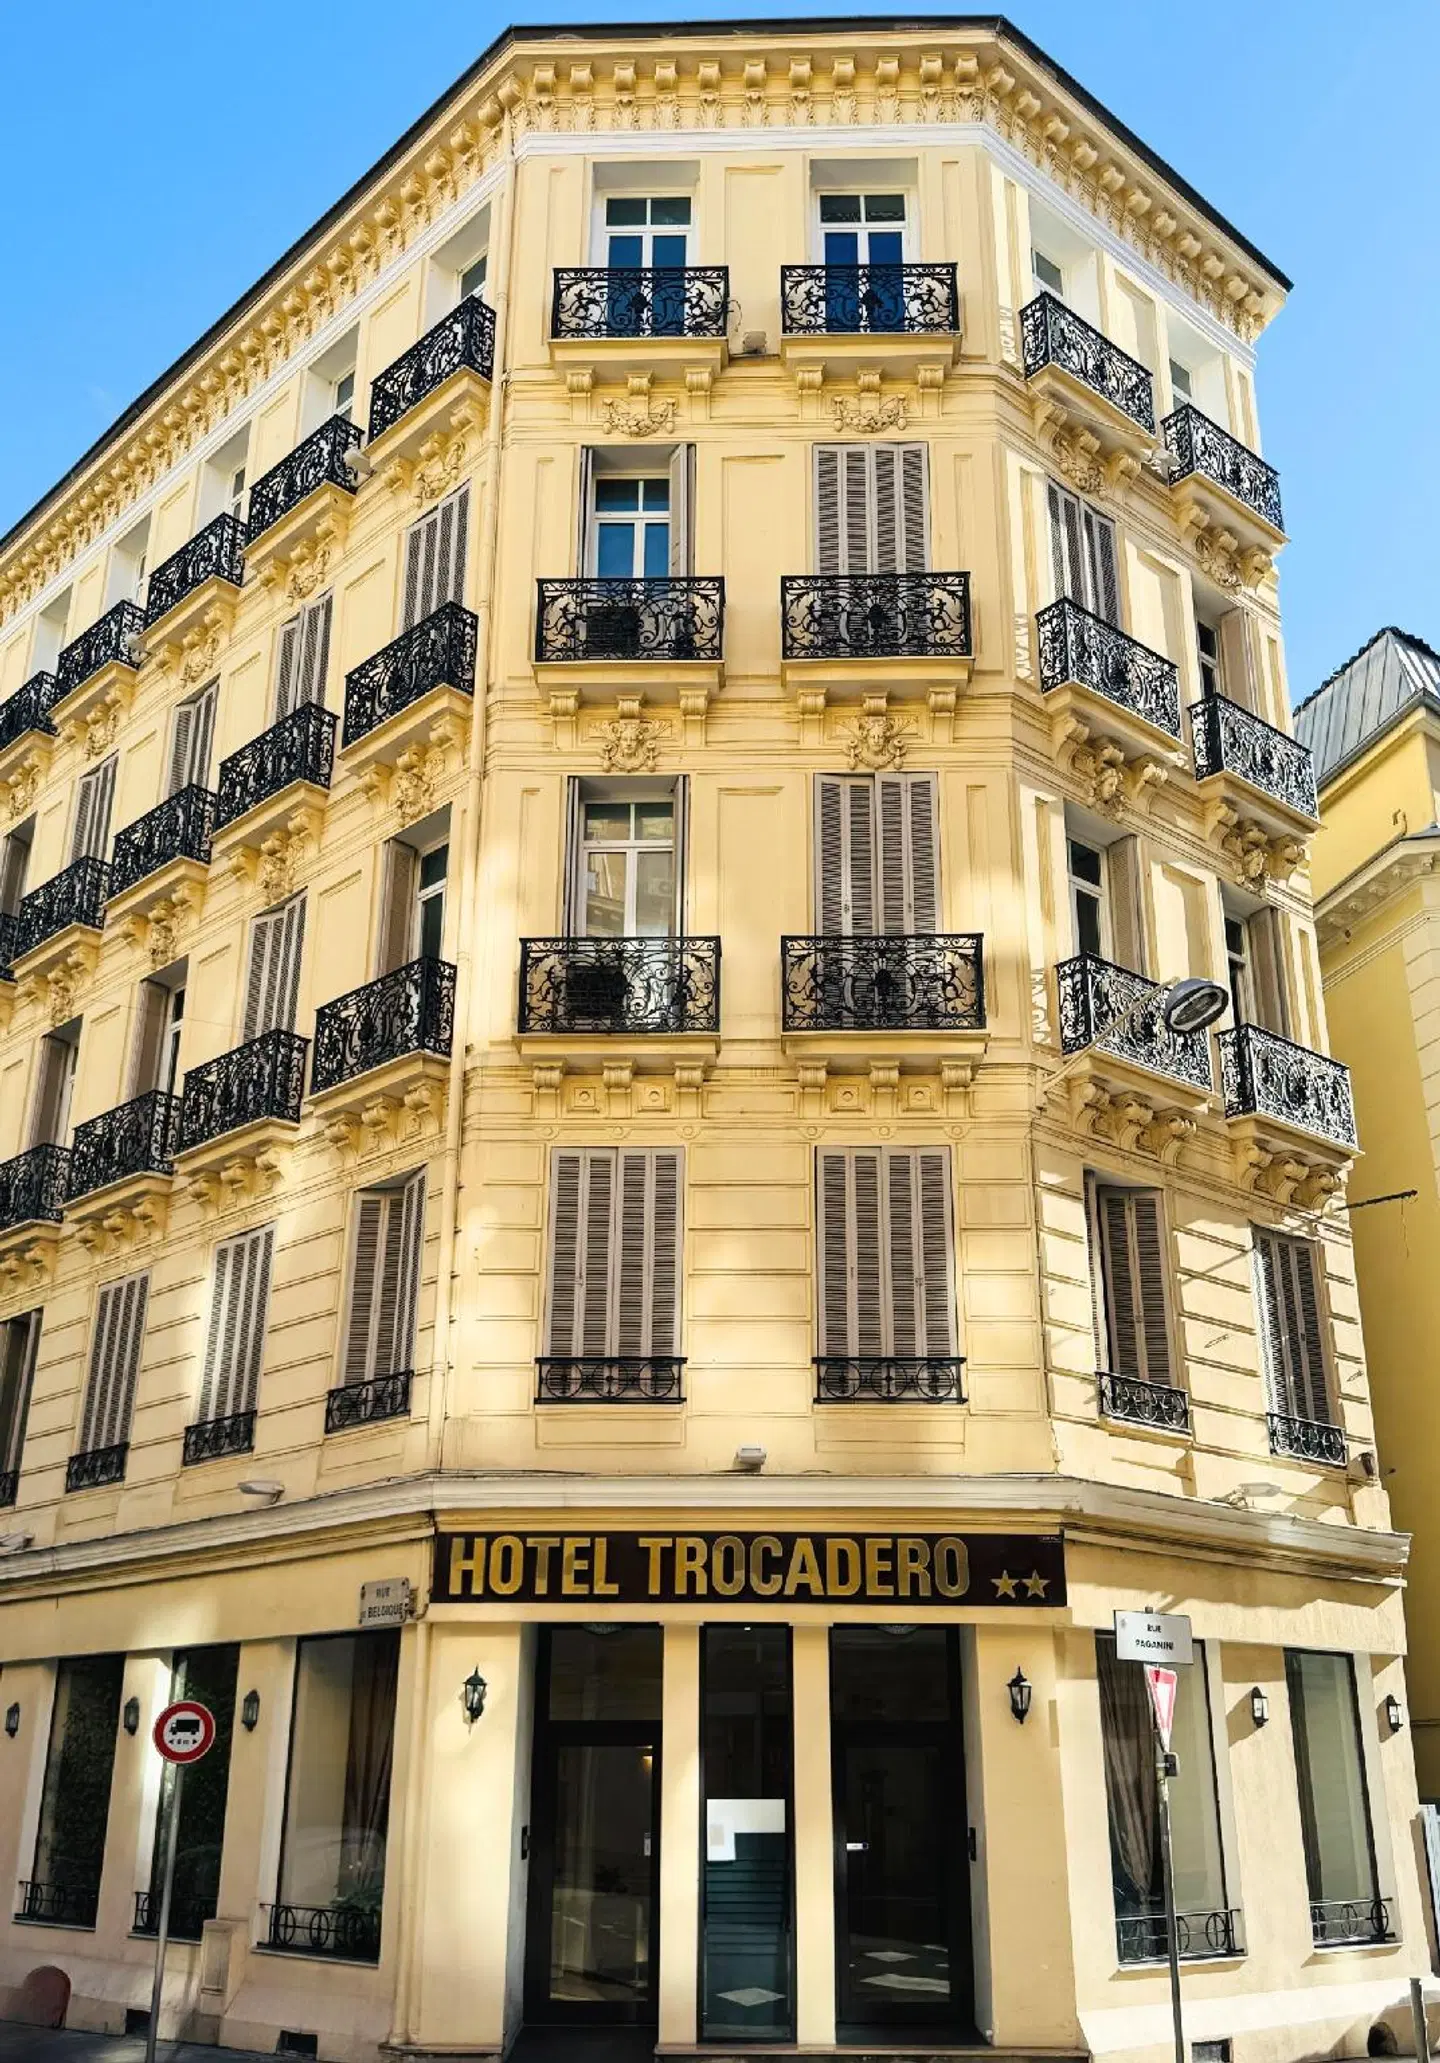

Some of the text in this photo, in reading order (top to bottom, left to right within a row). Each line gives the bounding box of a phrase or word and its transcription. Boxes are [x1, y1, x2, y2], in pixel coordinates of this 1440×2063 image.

[448, 1535, 970, 1597] HOTEL TROCADERO
[367, 1603, 403, 1618] BELGIQUE
[1147, 1623, 1162, 1633] RUE
[1135, 1639, 1174, 1650] PAGANINI
